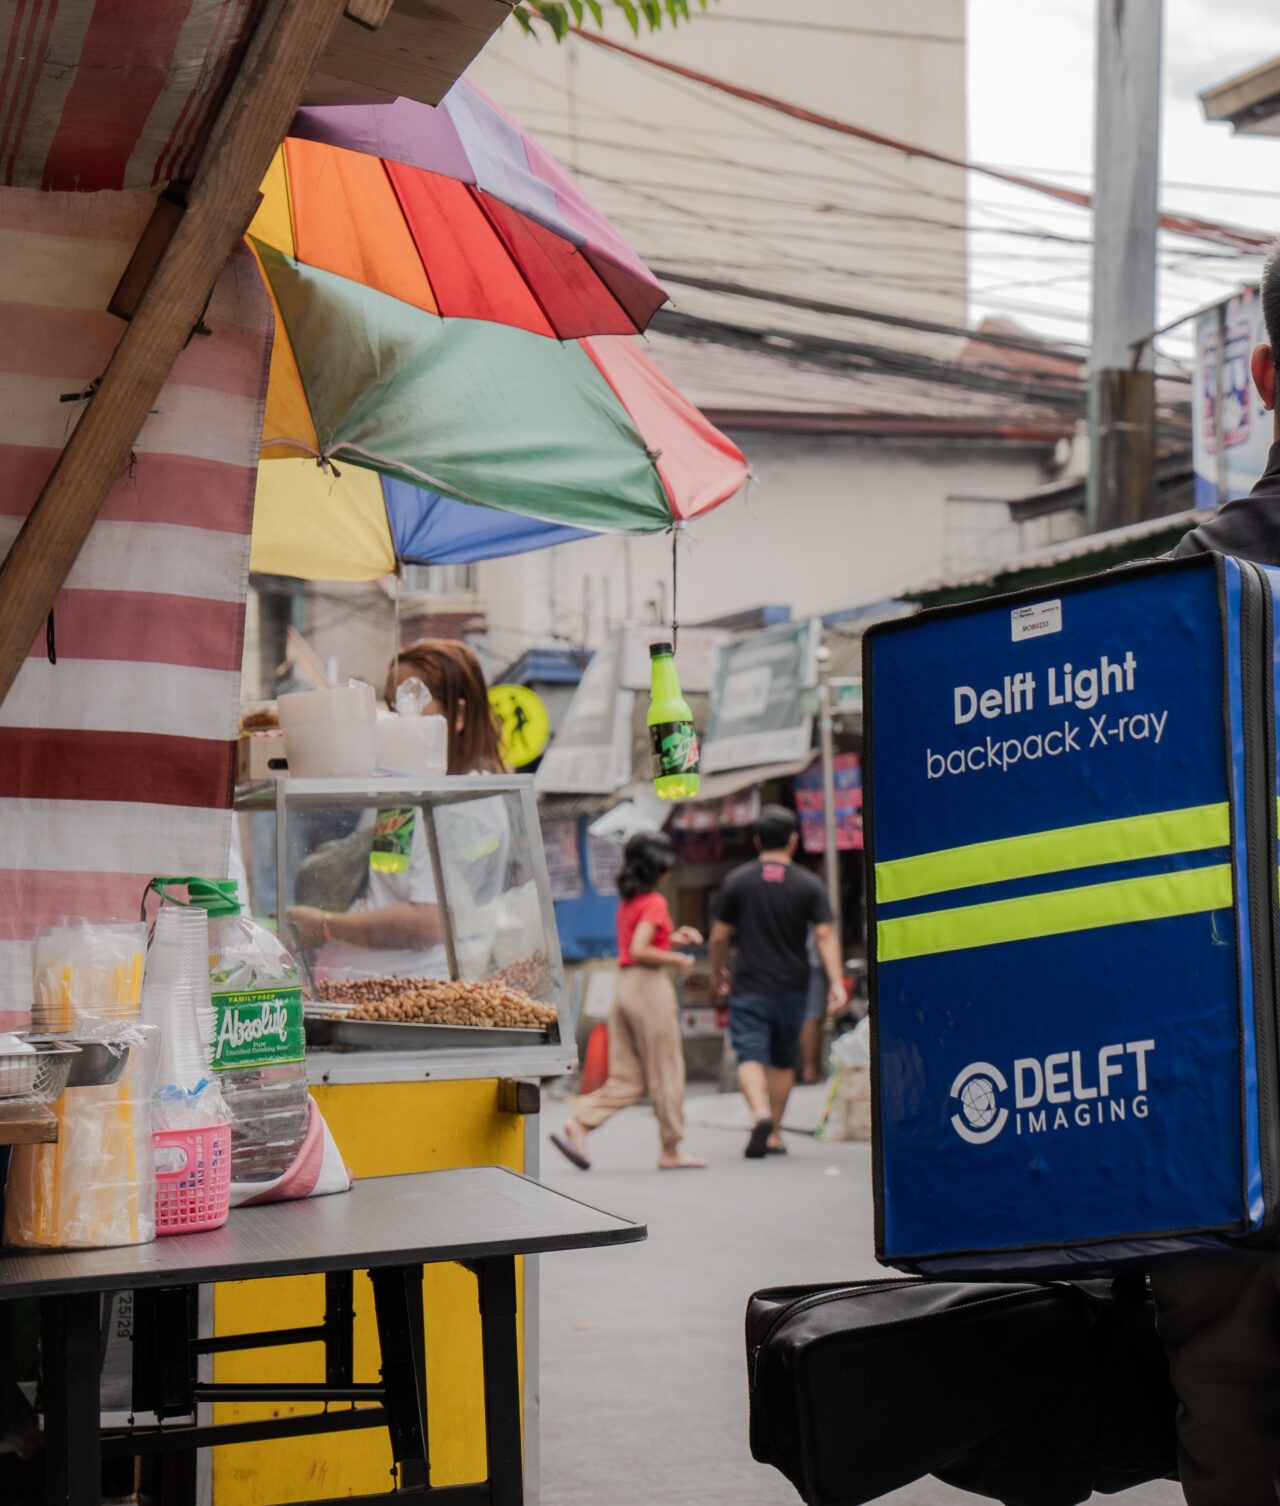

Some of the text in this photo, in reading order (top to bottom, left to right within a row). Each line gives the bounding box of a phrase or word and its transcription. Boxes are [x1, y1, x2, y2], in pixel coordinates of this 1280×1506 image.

[953, 651, 1137, 725] Delft Light
[927, 710, 1168, 779] backpack X-ray
[215, 999, 288, 1059] Absolute
[228, 995, 257, 1003] FAMILY
[1014, 1039, 1155, 1109] DELFT
[1015, 1095, 1149, 1135] IMAGING
[117, 1295, 133, 1338] 25/29
